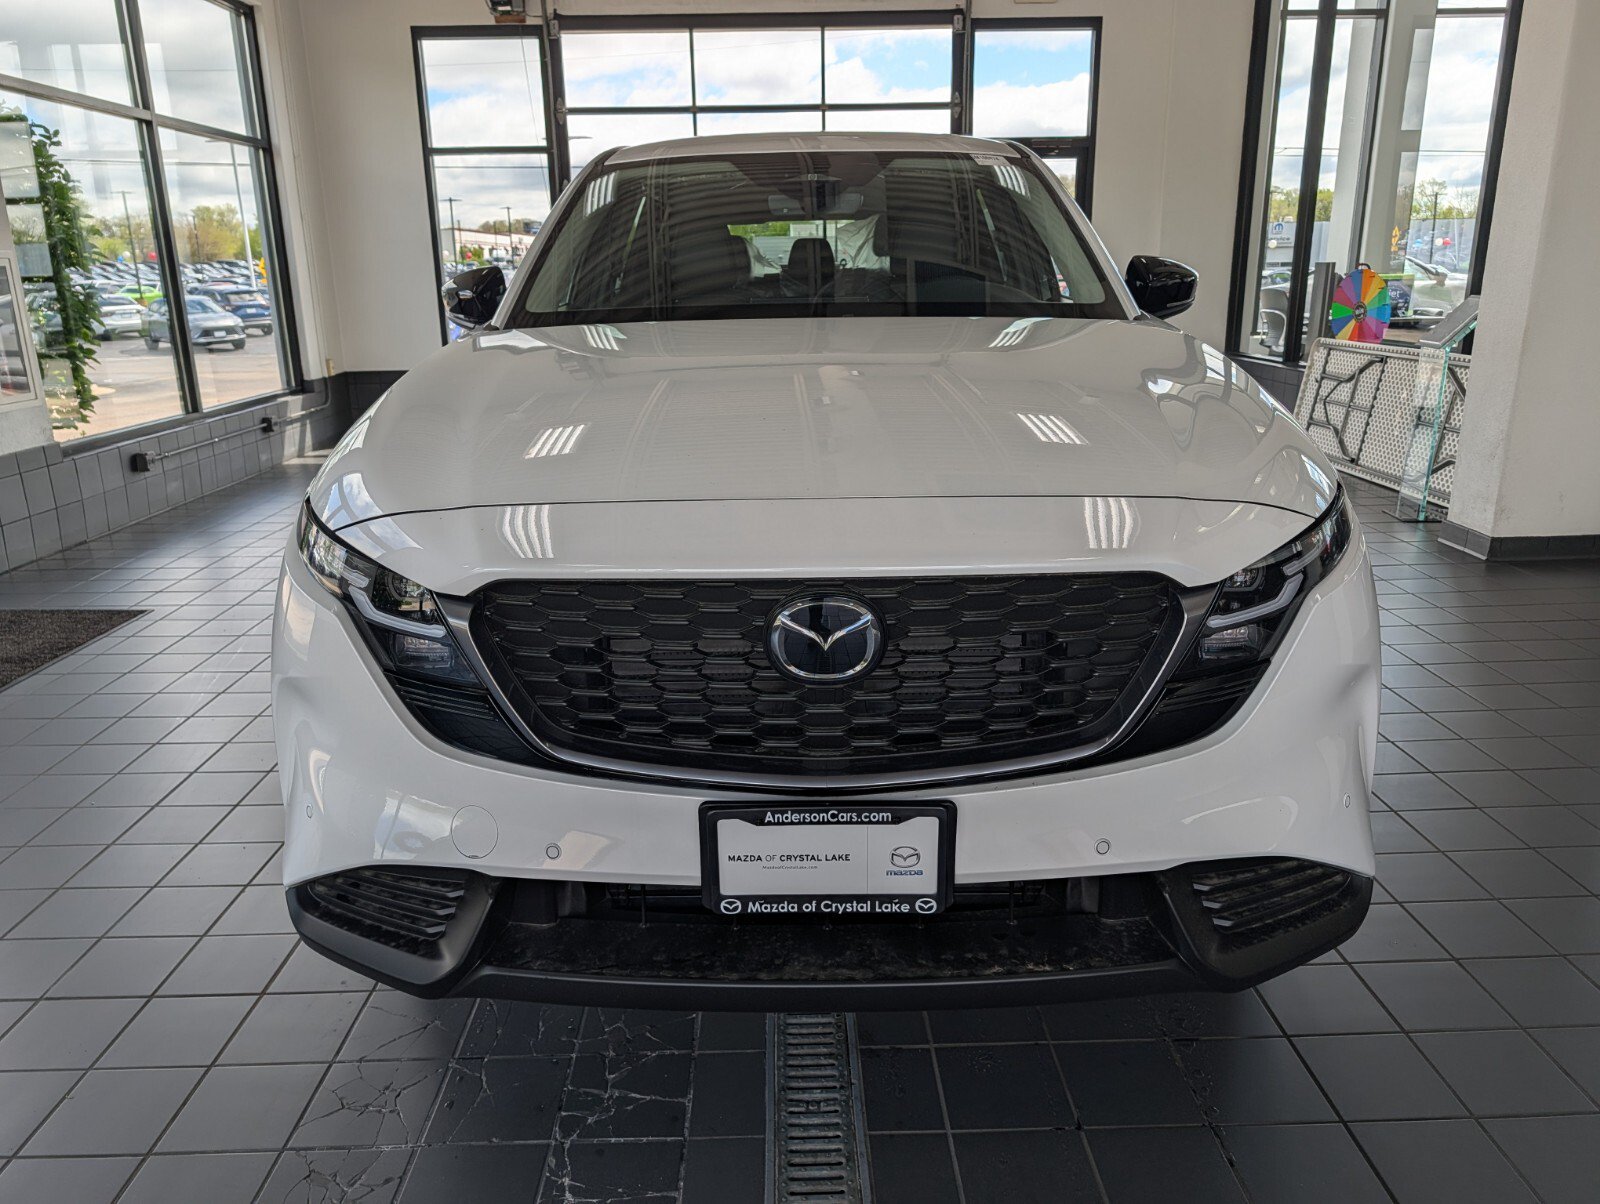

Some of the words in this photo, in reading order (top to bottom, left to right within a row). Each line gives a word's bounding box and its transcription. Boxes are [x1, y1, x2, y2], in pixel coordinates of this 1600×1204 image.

[764, 810, 892, 823] AndersonCars.com
[728, 854, 763, 862] MAZDA
[765, 854, 777, 862] OF
[779, 854, 823, 862] CRYSTAL
[825, 853, 851, 862] LAKE
[748, 901, 798, 913] Mazda
[802, 901, 817, 912] of
[820, 901, 871, 915] Crystal
[875, 901, 910, 913] Lake
